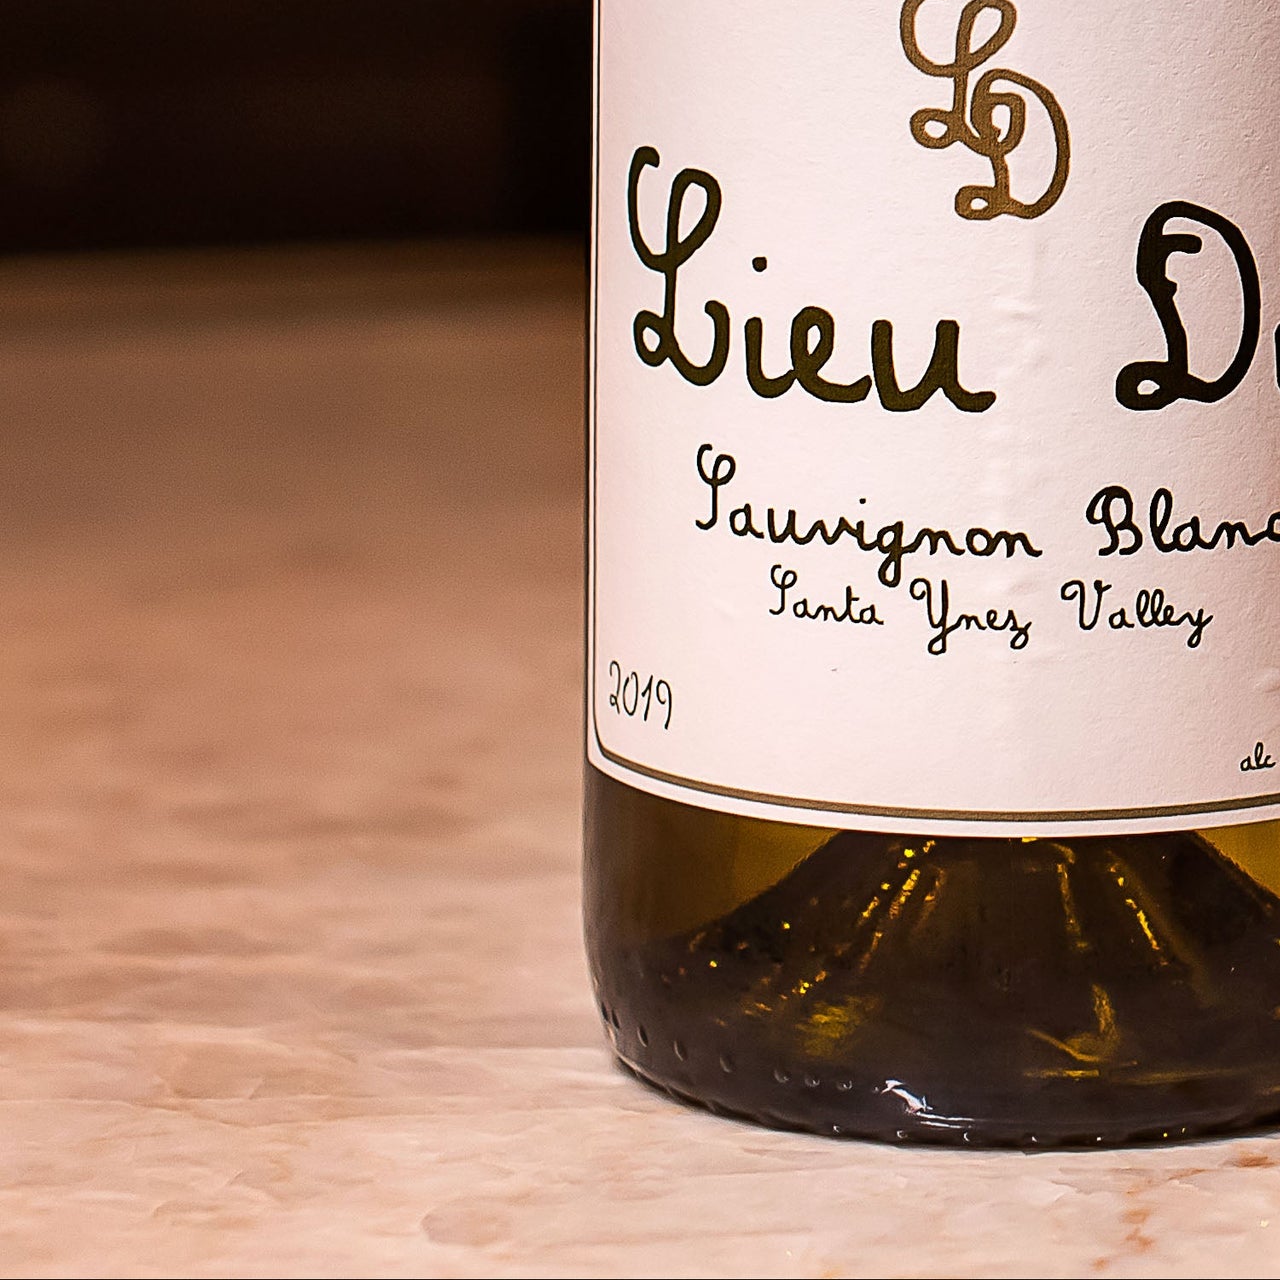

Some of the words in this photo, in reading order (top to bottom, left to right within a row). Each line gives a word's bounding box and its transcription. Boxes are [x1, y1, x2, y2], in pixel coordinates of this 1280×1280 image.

[627, 145, 996, 413] Lieu
[695, 443, 1043, 588] Sauvignon
[768, 563, 886, 627] Santa
[908, 577, 1033, 656] Ynez
[1060, 579, 1214, 649] Valley
[607, 659, 673, 731] 2019
[1239, 741, 1277, 772] alc
